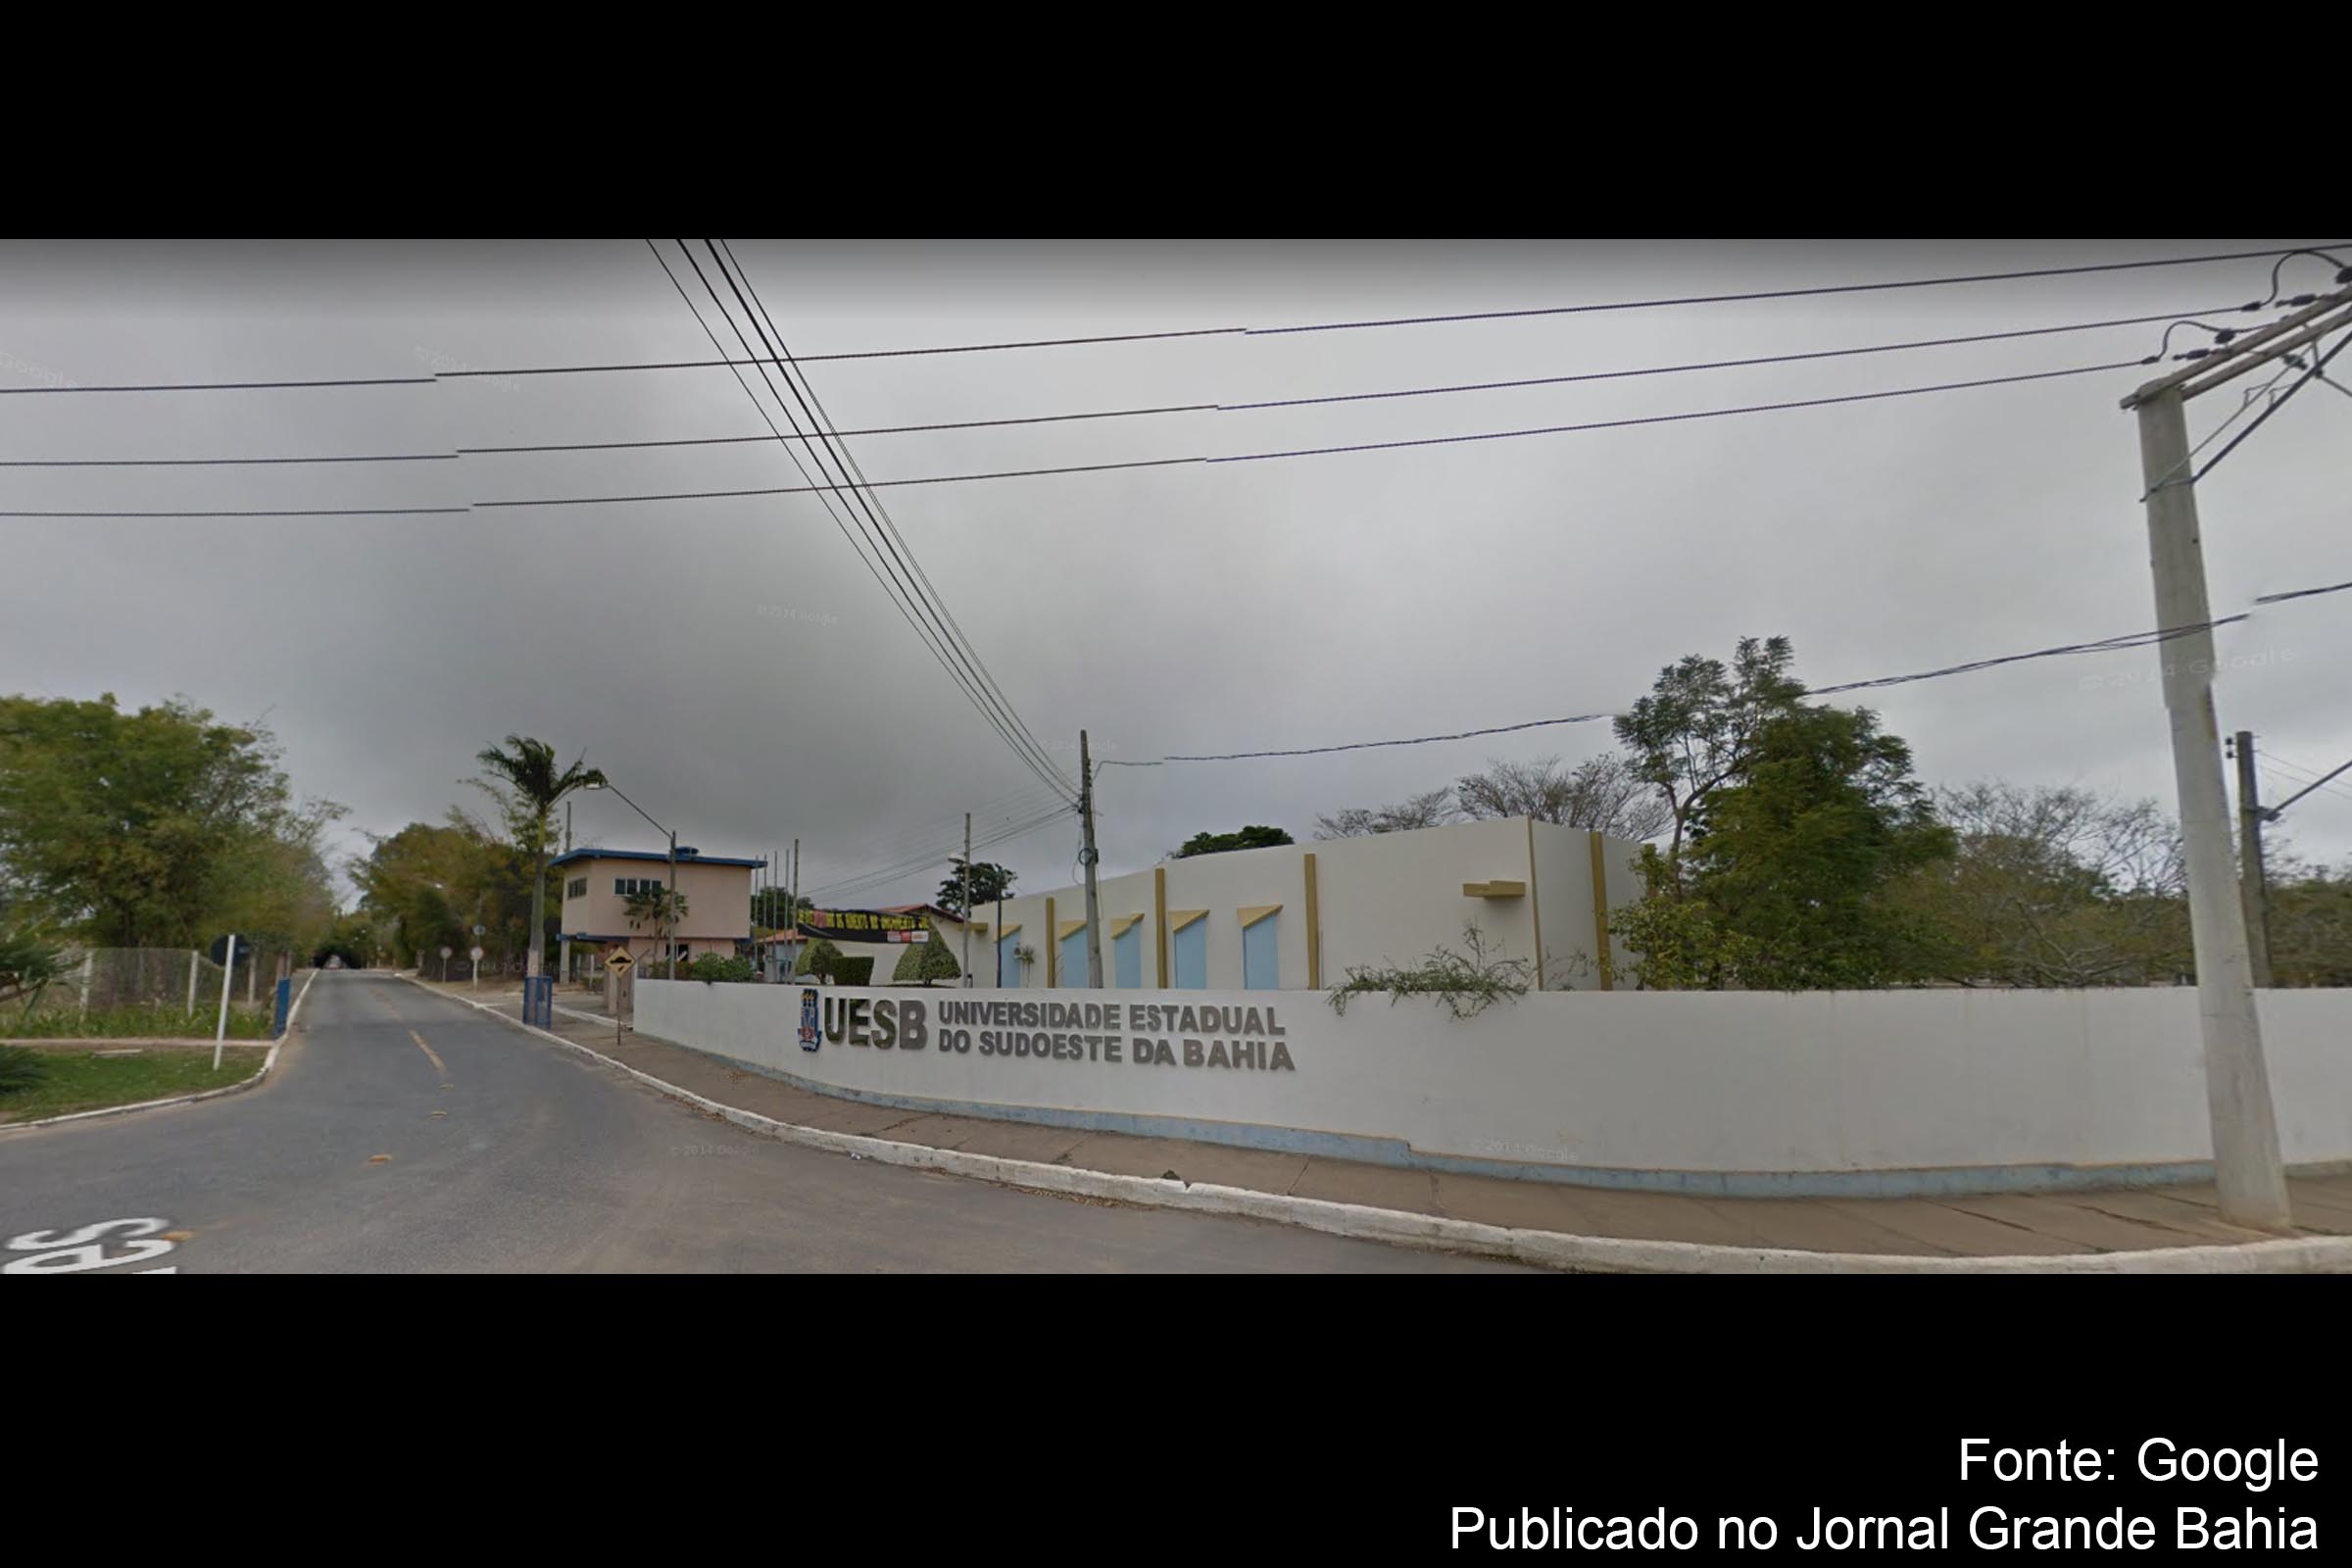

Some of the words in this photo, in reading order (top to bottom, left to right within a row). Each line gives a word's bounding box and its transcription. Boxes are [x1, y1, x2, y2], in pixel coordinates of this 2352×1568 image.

[824, 997, 929, 1052] UESB
[938, 1001, 1121, 1031] UNIVERSIDADE
[1129, 1004, 1287, 1036] ESTADUAL
[938, 1028, 971, 1054] DO
[978, 1030, 1123, 1064] SUDOESTE
[1133, 1037, 1176, 1066] DA
[1183, 1039, 1296, 1072] BAHIA
